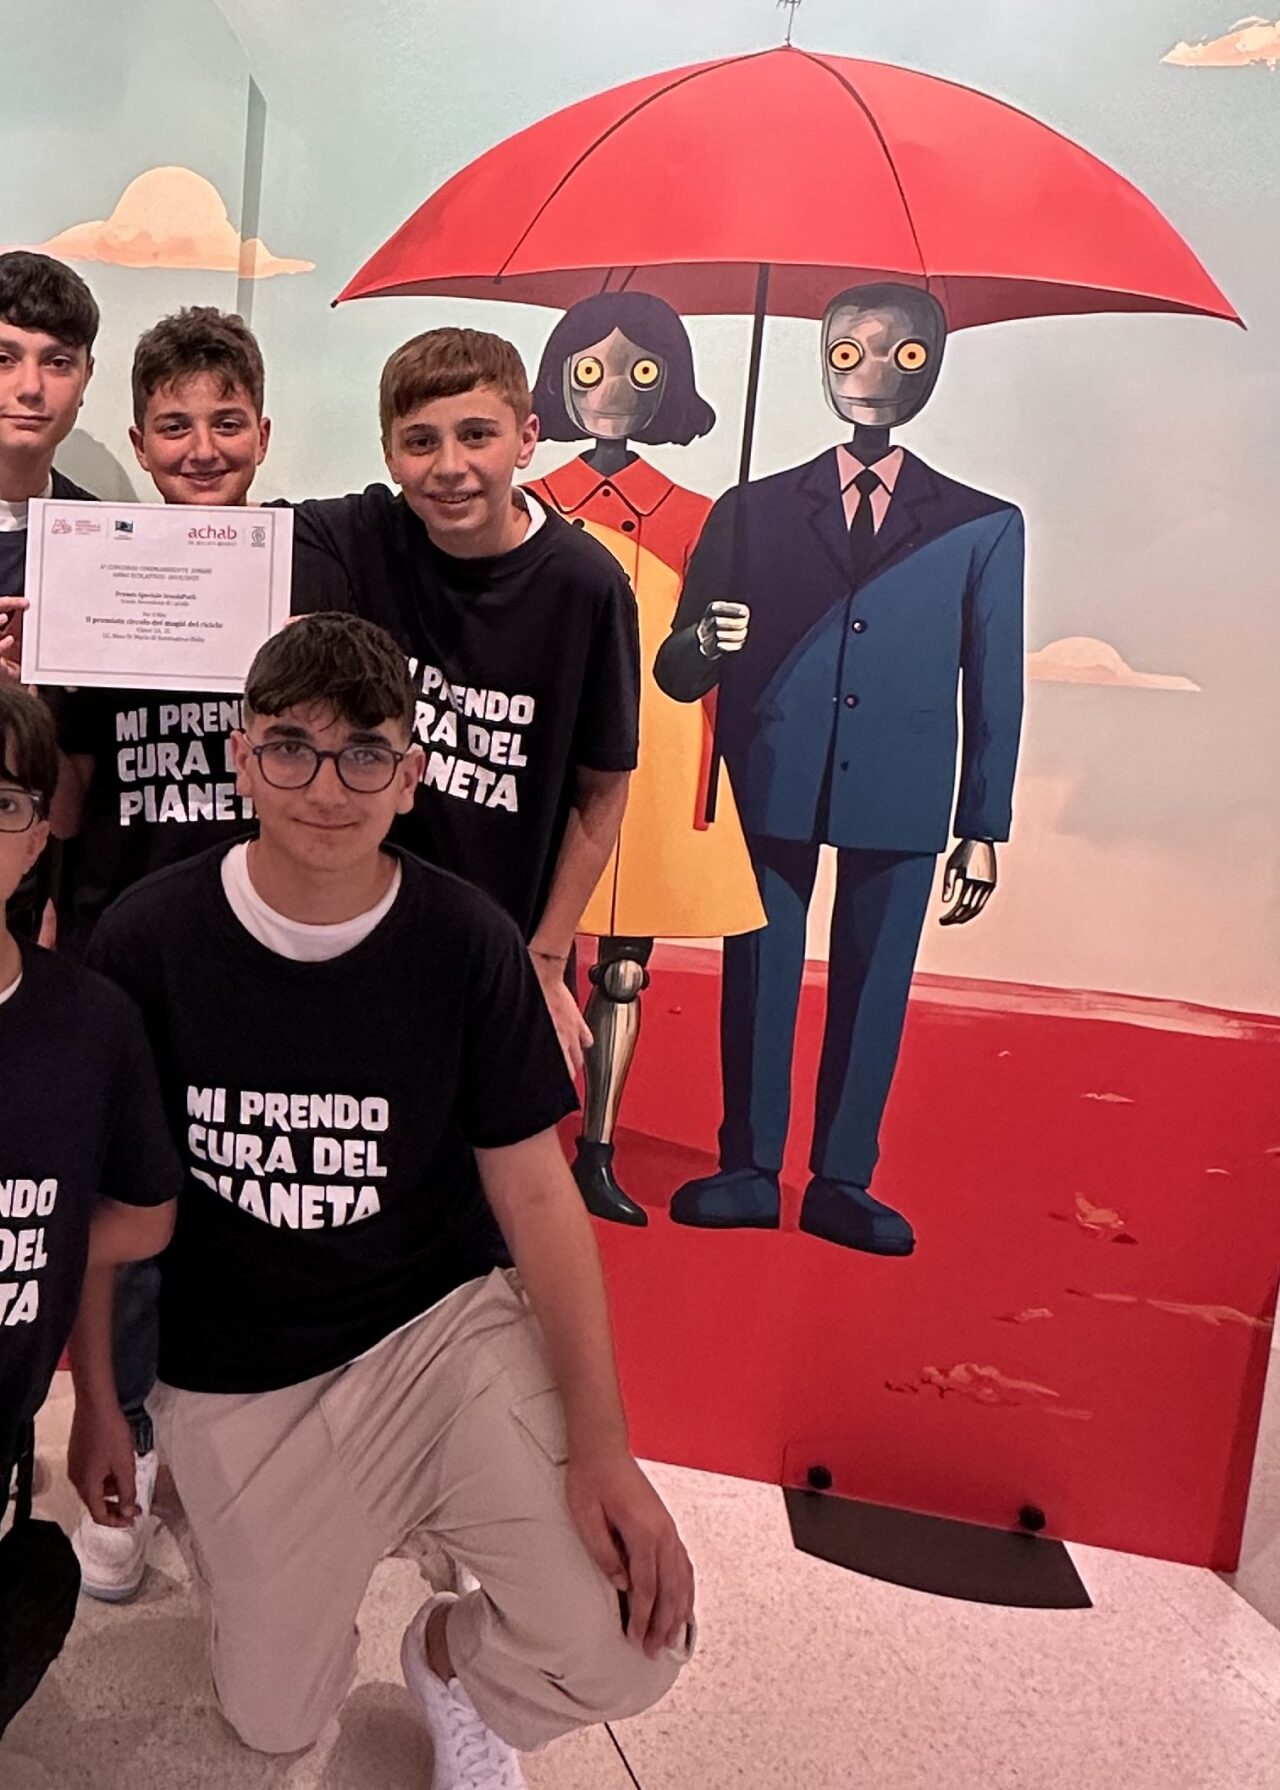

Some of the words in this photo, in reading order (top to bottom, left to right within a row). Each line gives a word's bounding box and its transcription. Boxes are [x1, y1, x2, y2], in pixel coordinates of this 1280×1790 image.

[187, 524, 237, 539] achab
[116, 707, 148, 742] MI
[160, 700, 246, 737] PREN
[412, 700, 457, 748] RA
[468, 724, 528, 767] DEL
[117, 740, 211, 782] CURA
[419, 751, 518, 812] NETA
[120, 783, 259, 826] PIANE
[187, 1085, 226, 1123] MI
[239, 1091, 389, 1132] PRENDO
[188, 1123, 297, 1177] CURA
[313, 1136, 388, 1177] DEL
